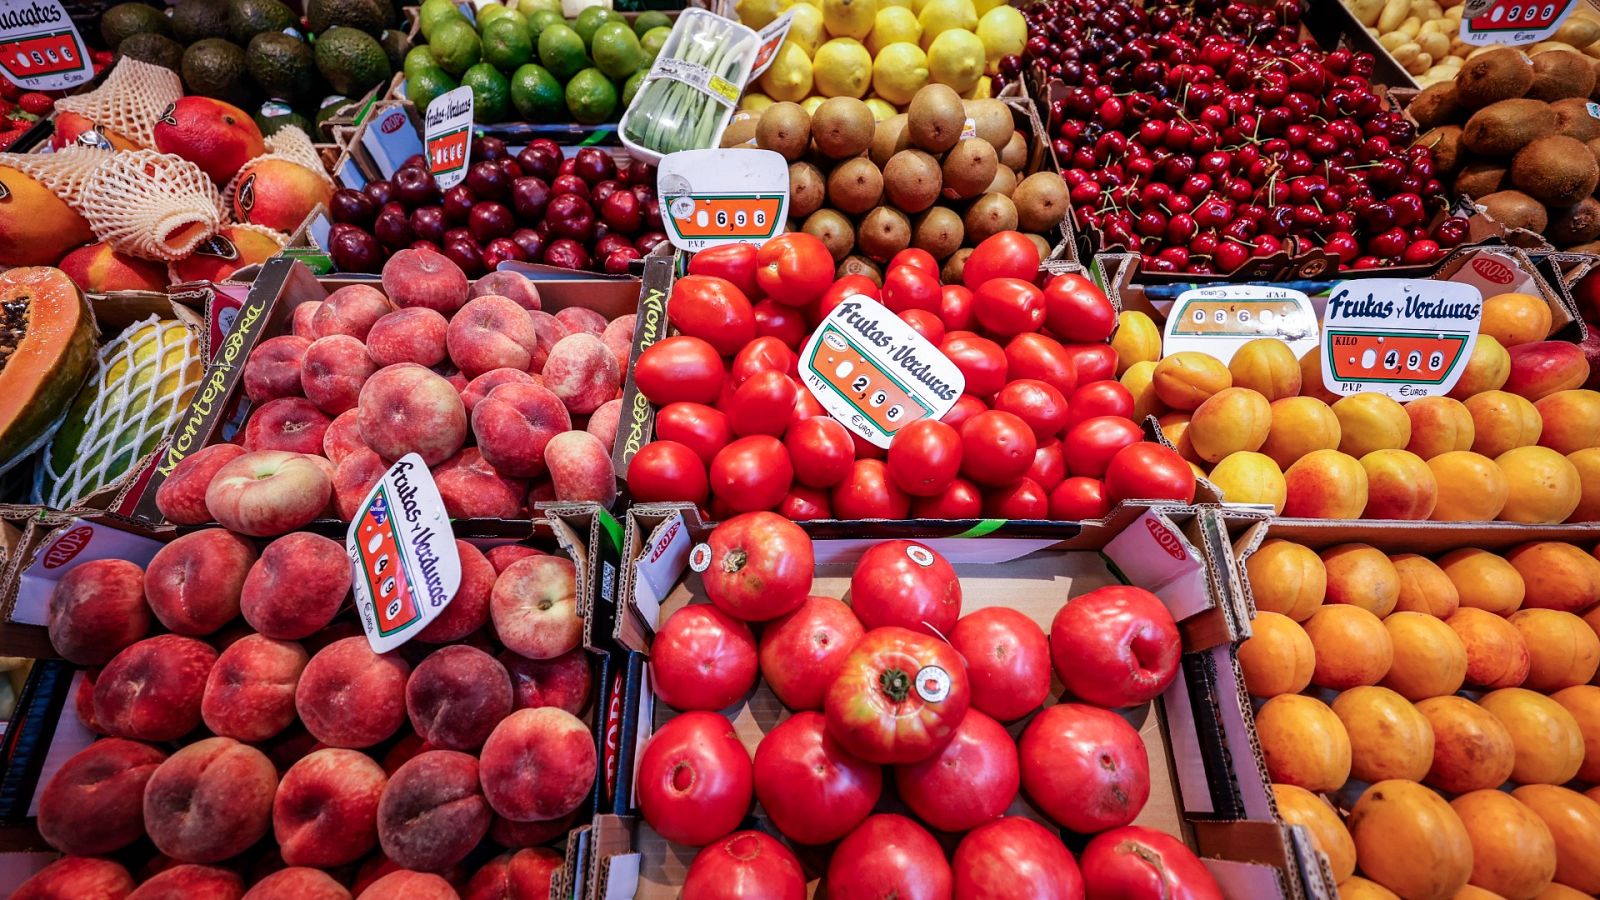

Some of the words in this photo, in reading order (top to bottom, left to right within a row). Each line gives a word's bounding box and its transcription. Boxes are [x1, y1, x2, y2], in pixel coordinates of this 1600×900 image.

[1473, 259, 1513, 284] TROPS
[1329, 289, 1394, 319] Frutas
[1404, 294, 1481, 321] Verduras
[837, 302, 893, 348] Frutas
[892, 345, 959, 401] Verduras
[1335, 336, 1358, 346] KILO
[45, 527, 93, 567] TROPS
[391, 461, 421, 523] Frutas
[411, 527, 448, 608] Verduras
[651, 522, 680, 562] TROPS
[1147, 520, 1185, 559] TROPS
